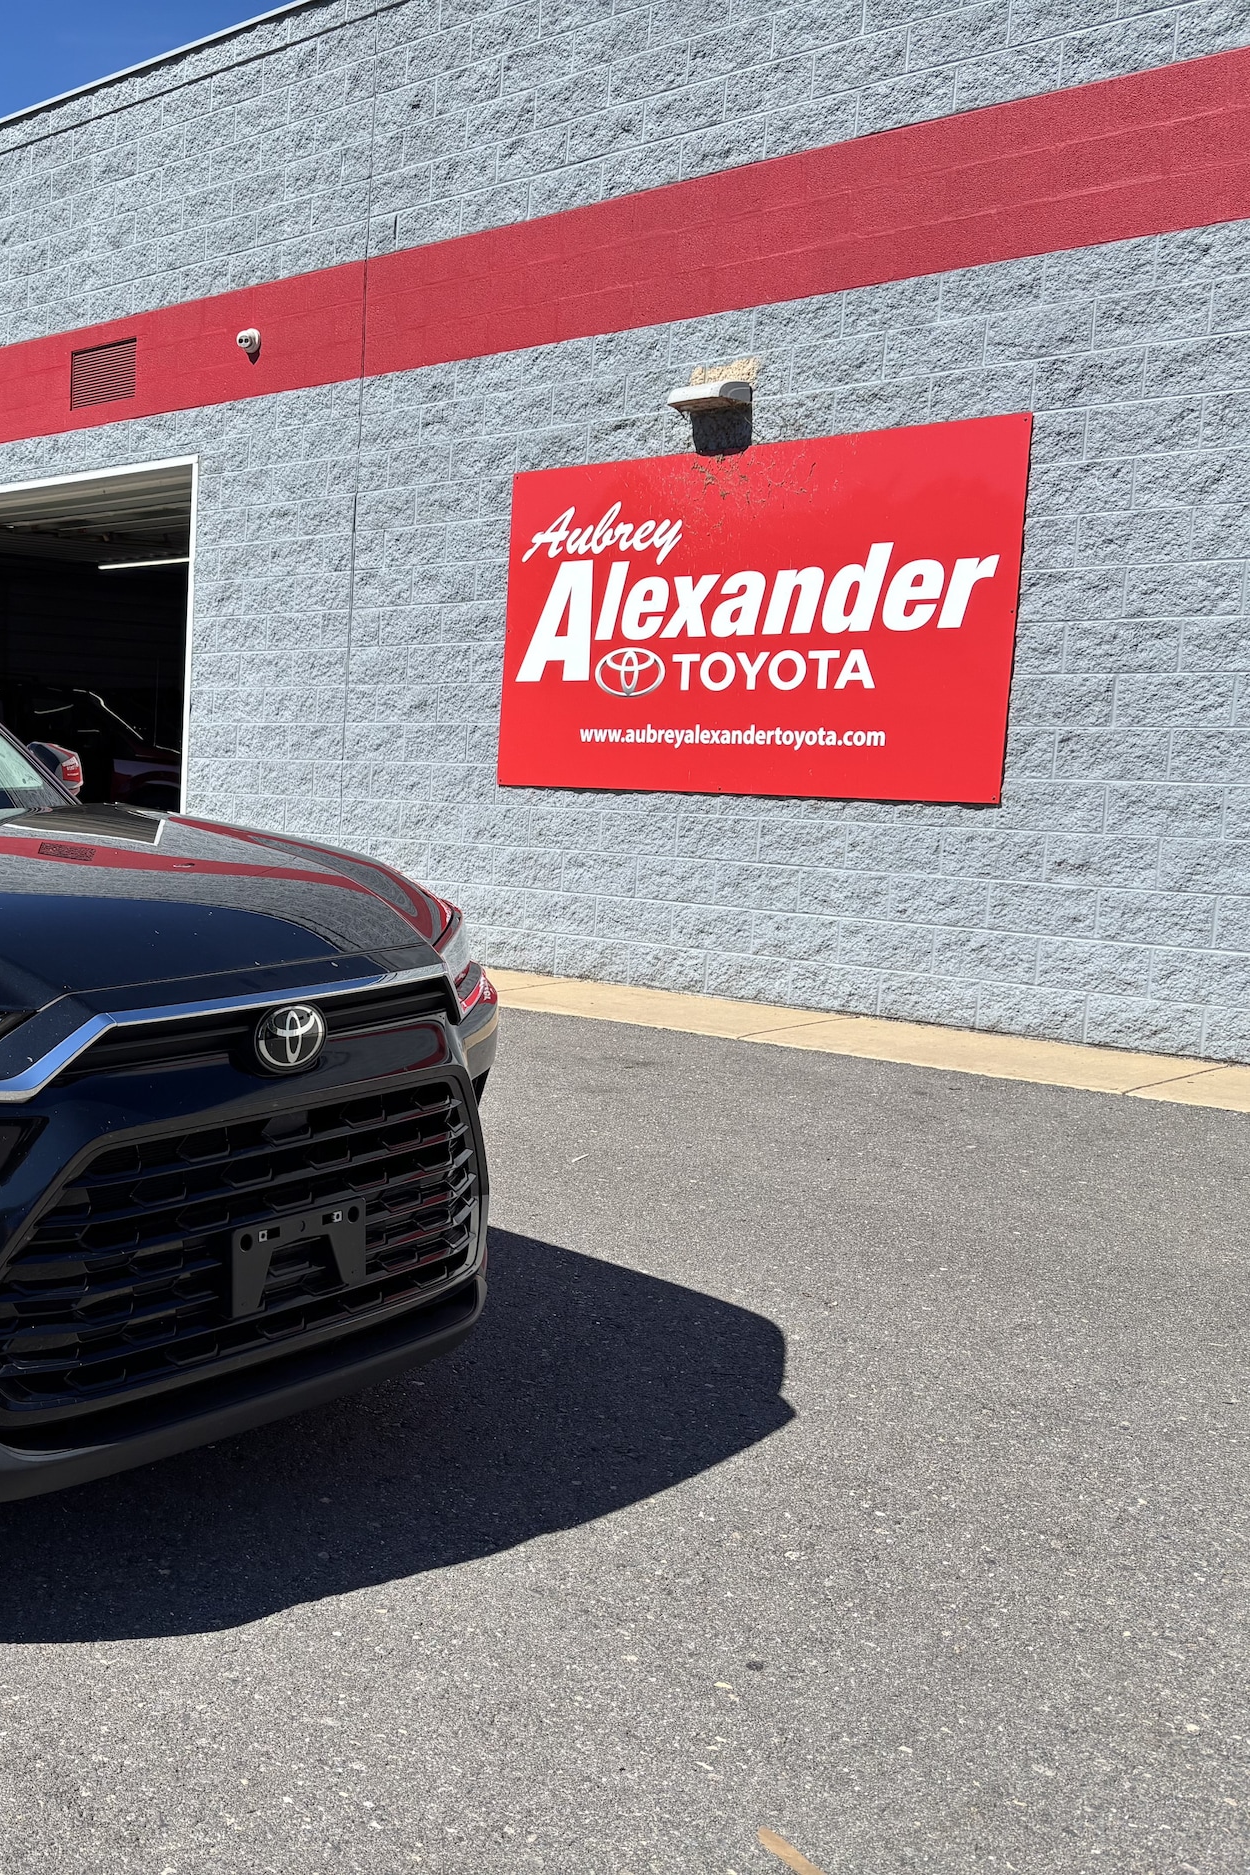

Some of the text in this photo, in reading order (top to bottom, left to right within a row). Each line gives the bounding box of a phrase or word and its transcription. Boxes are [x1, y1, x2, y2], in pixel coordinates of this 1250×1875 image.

[521, 501, 683, 566] Aubrey
[515, 541, 1000, 683] Alexander
[672, 649, 876, 692] TOYOTA
[579, 723, 886, 751] www.aubreyalexandertoyota.com
